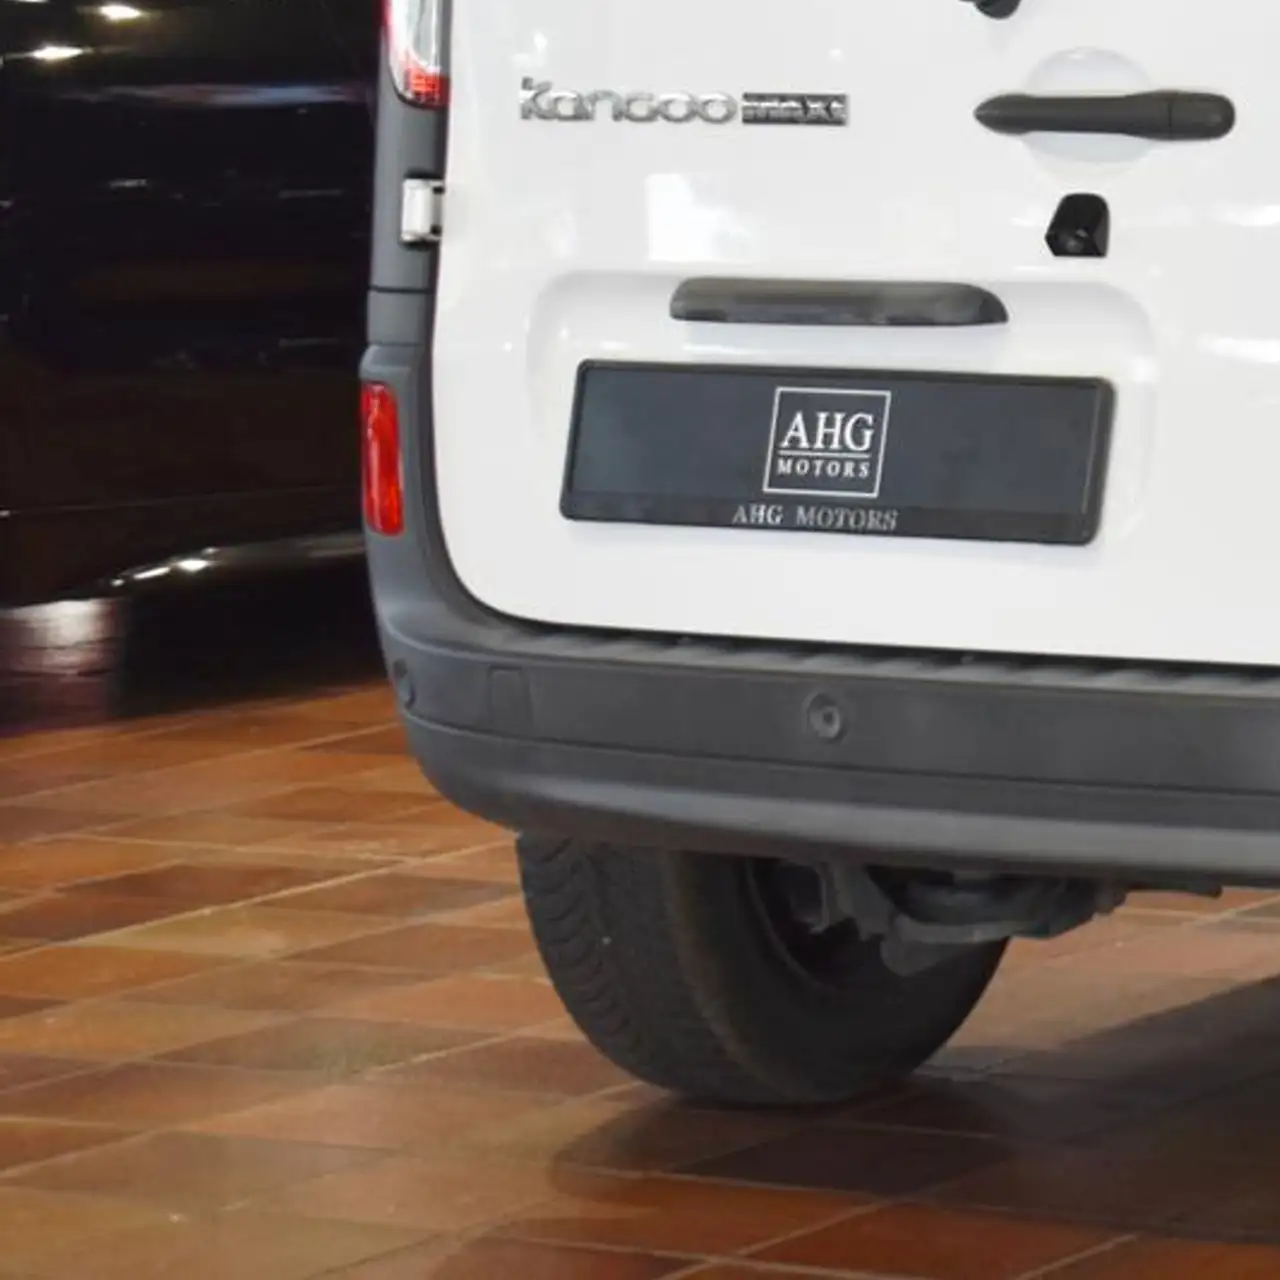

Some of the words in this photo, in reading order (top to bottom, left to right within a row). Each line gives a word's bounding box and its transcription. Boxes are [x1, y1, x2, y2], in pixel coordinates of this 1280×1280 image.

[779, 410, 874, 451] AHG
[776, 458, 870, 478] MOTORS
[732, 504, 783, 525] AHG
[796, 506, 899, 531] MOTORS
